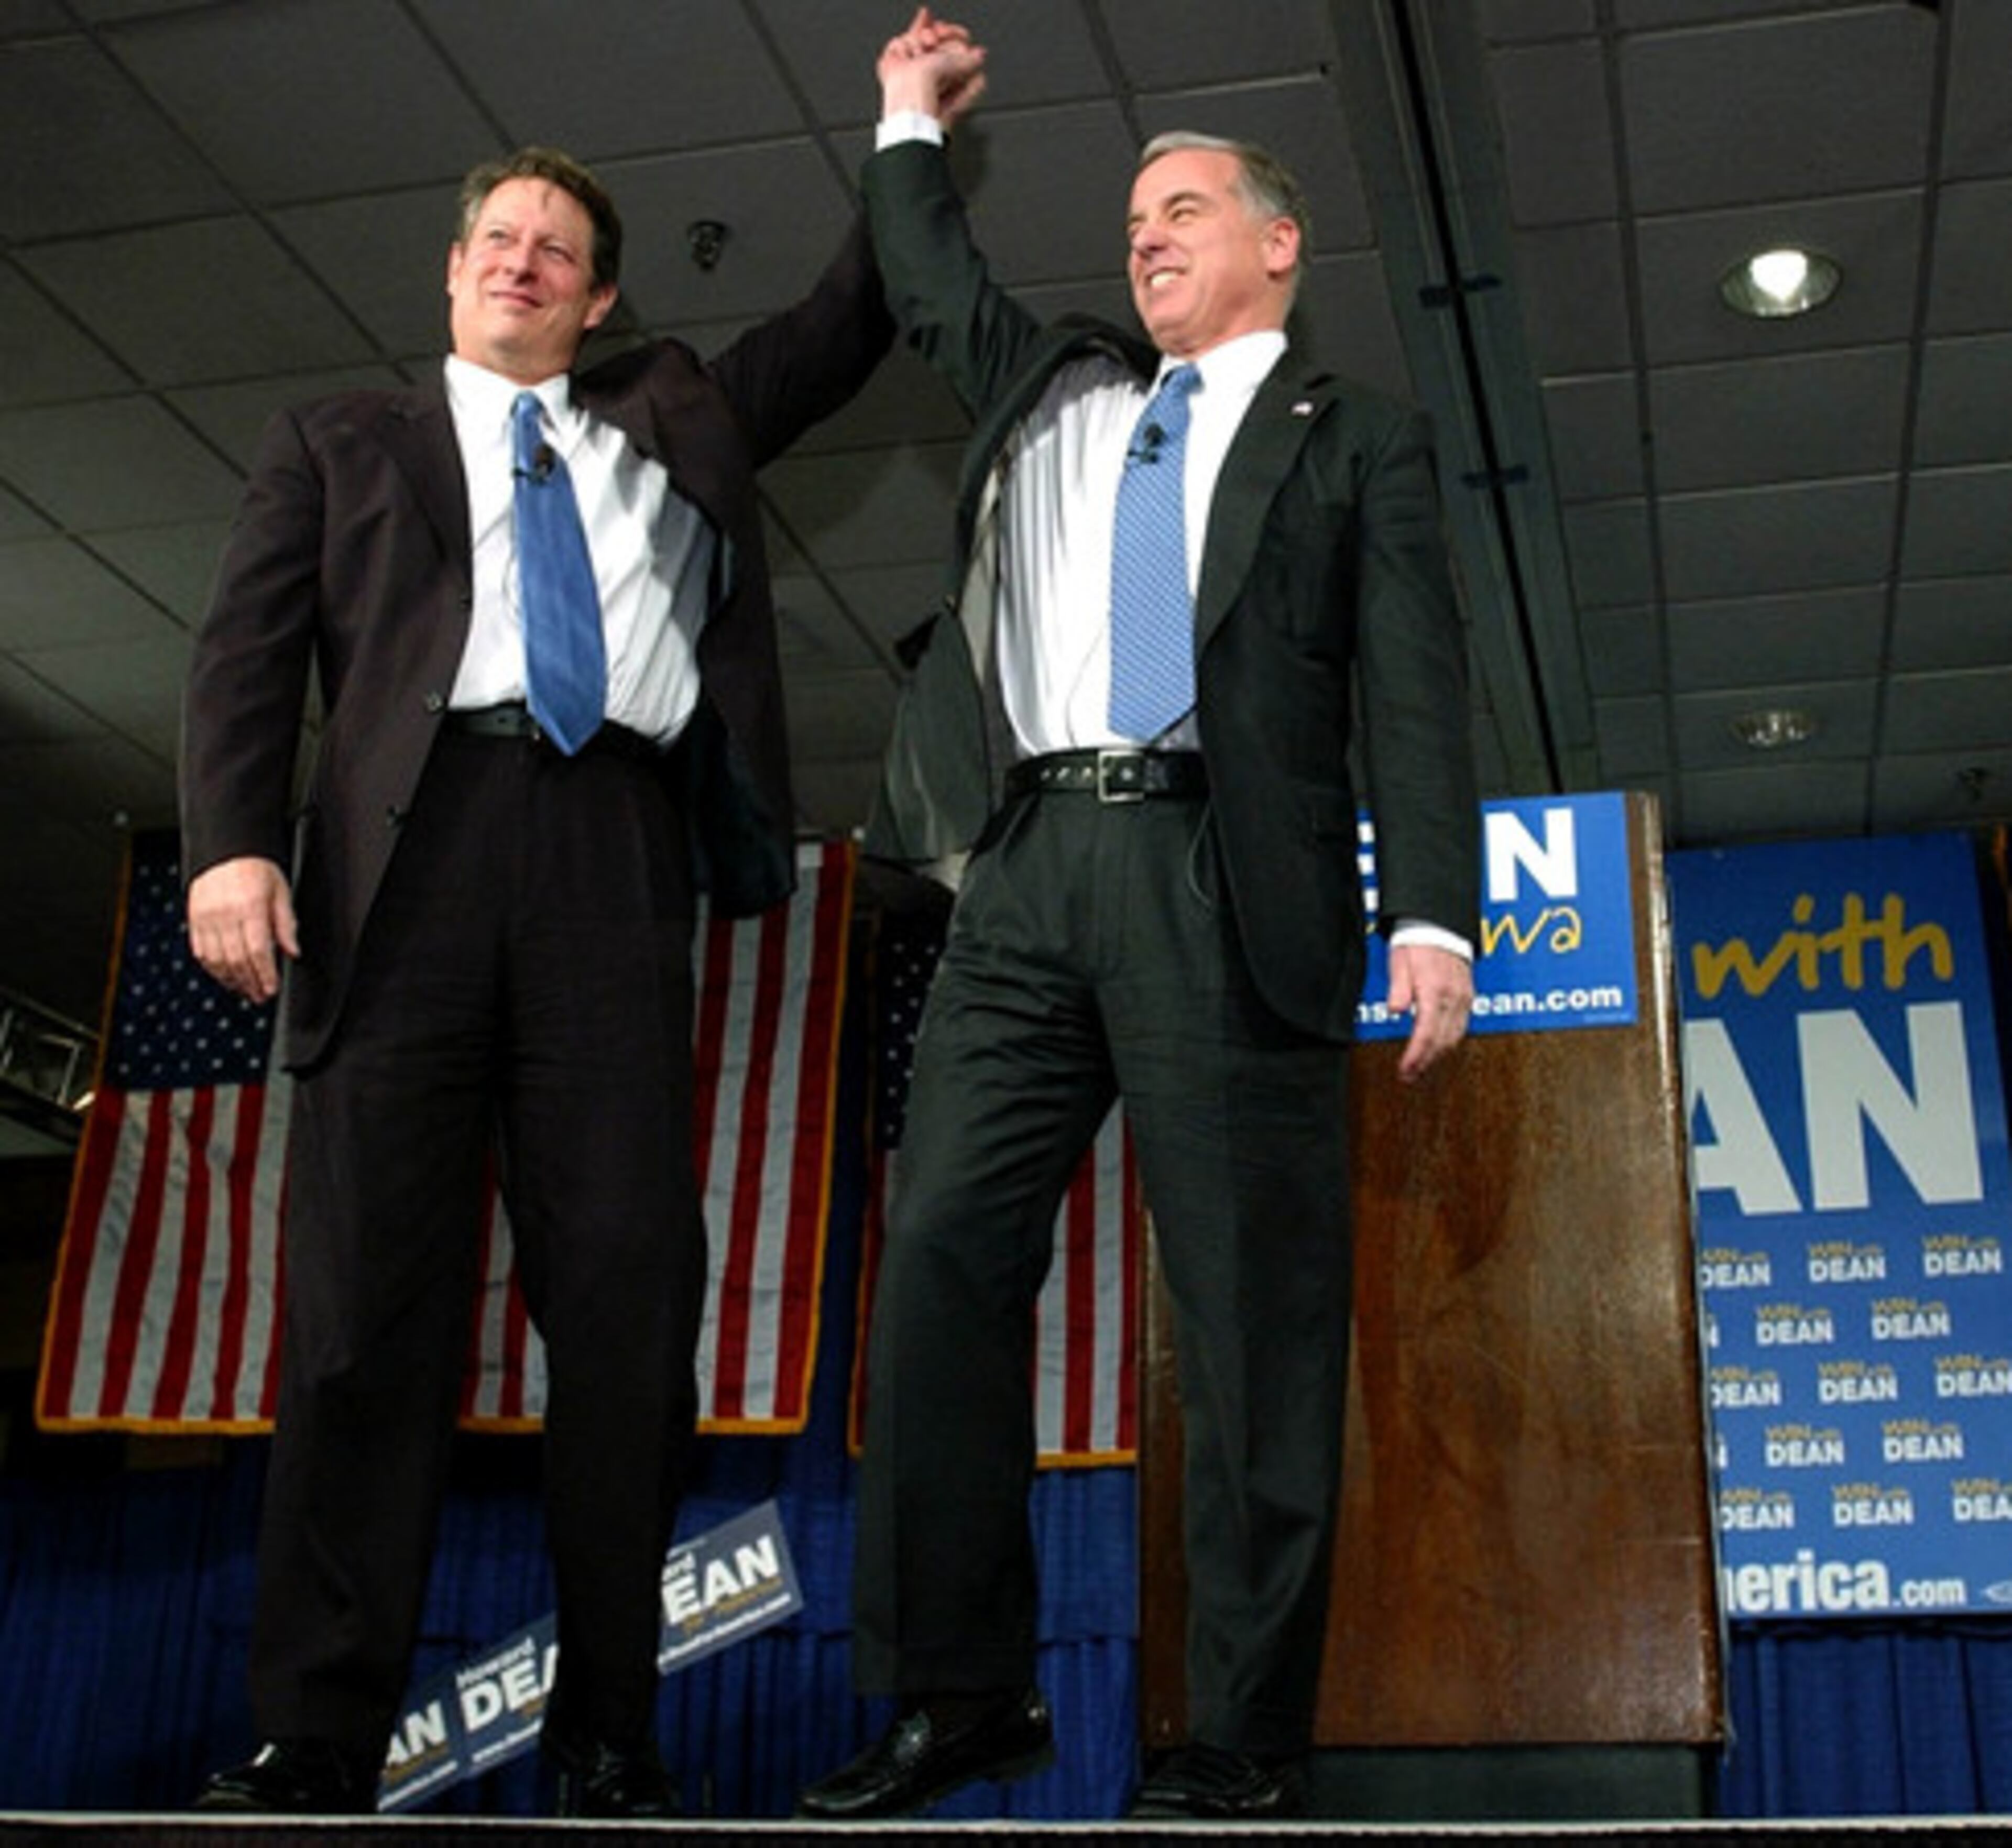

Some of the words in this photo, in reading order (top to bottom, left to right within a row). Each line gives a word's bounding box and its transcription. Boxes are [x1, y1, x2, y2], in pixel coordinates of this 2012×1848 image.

[1691, 892, 1955, 1000] with
[1809, 1255, 1886, 1283] DEAN
[1924, 1248, 2002, 1276] DEAN
[1756, 1318, 1834, 1346] DEAN
[1872, 1312, 1950, 1340] DEAN
[1819, 1376, 1898, 1404] DEAN
[1936, 1369, 2012, 1397] DEAN
[1765, 1439, 1844, 1467] DEAN
[1883, 1435, 1964, 1463] DEAN
[1833, 1499, 1914, 1526] DEAN
[662, 1534, 779, 1625] EAN
